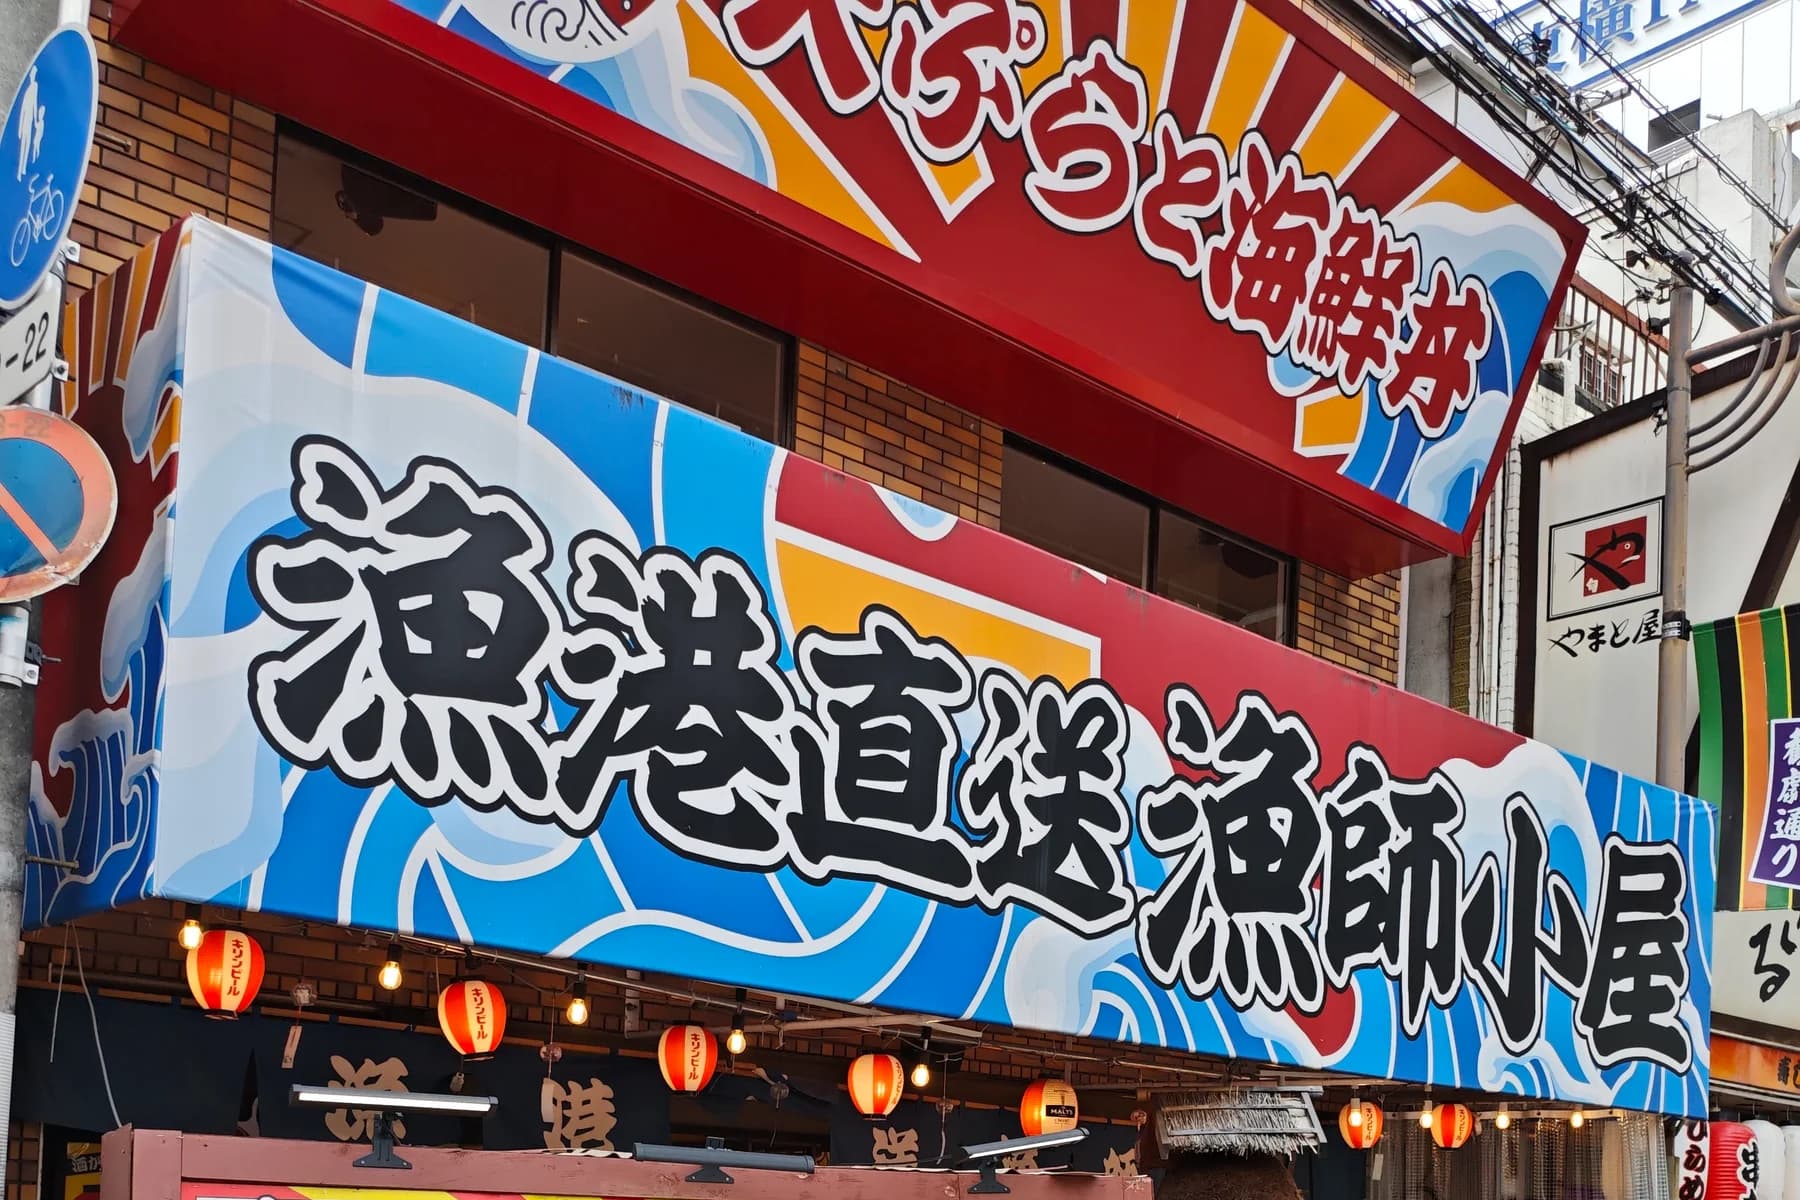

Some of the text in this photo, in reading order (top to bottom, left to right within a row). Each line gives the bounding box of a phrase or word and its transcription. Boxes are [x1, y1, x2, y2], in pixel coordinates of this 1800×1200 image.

[1547, 609, 1663, 659] やまと屋
[248, 435, 1692, 1082] 漁港直送漁師小屋
[226, 938, 245, 997] キリンビール
[470, 987, 489, 1040] キリンビール
[688, 1032, 701, 1081] キリンビール
